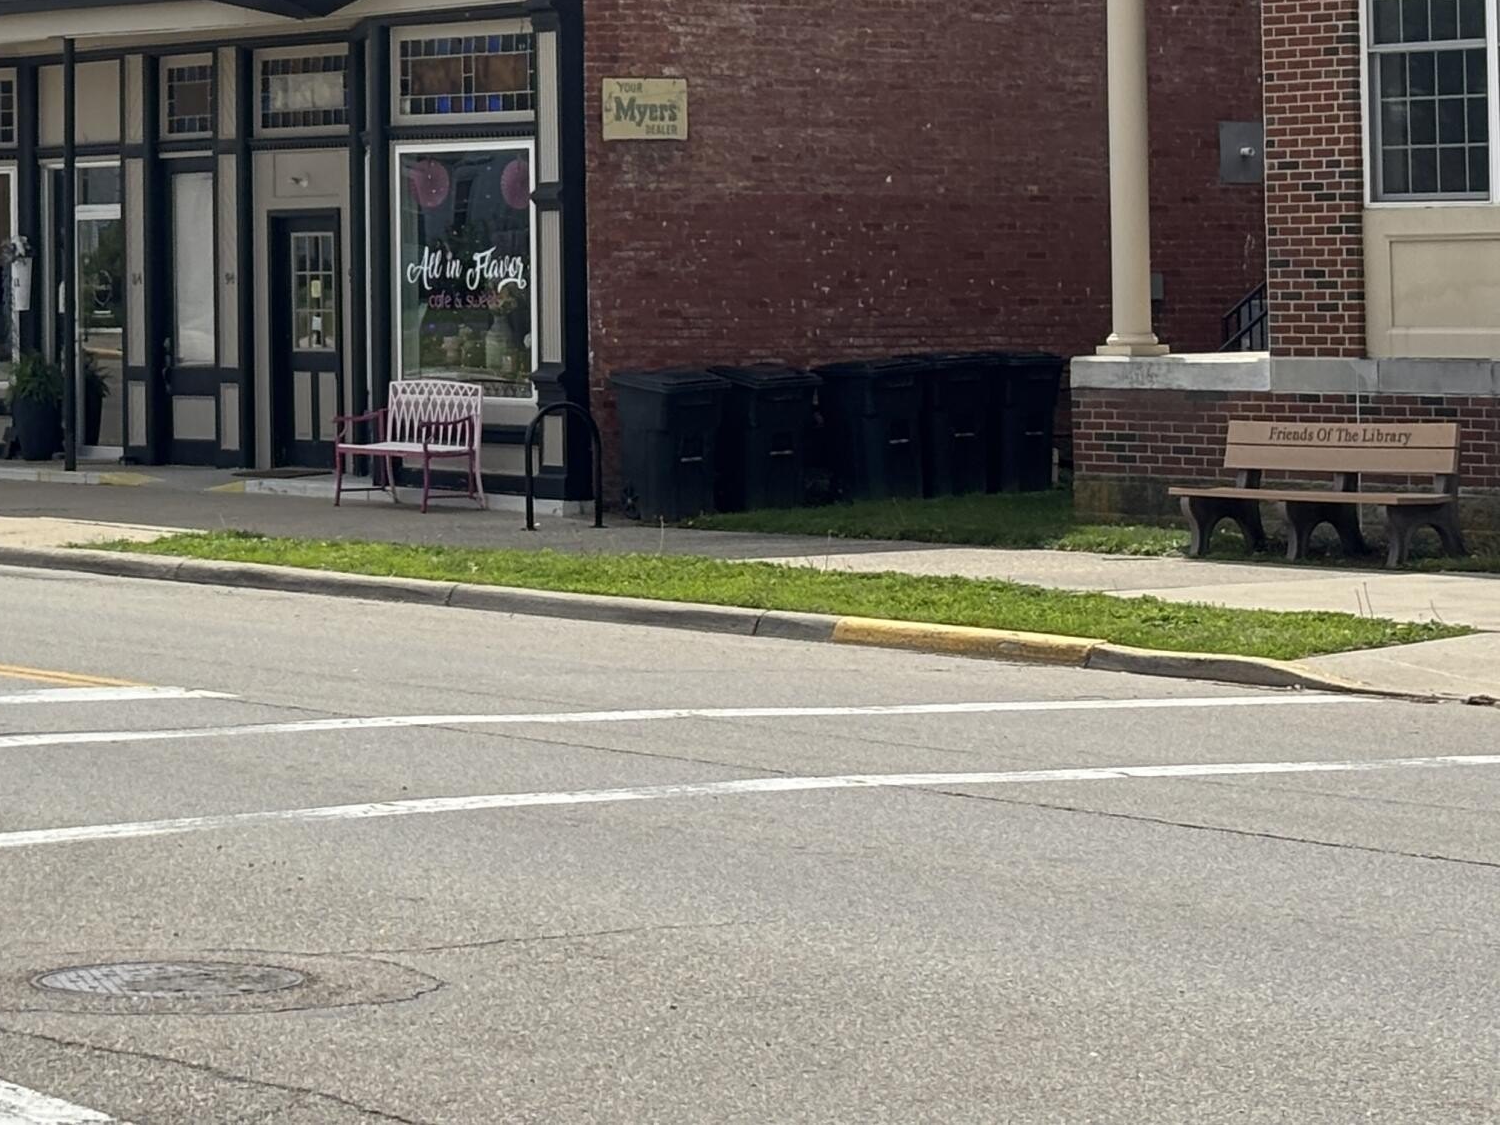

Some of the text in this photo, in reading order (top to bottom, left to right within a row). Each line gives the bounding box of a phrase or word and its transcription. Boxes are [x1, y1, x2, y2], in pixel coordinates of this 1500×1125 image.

[616, 81, 643, 94] YOUR
[614, 95, 678, 127] Myers
[406, 245, 527, 293] All in Flavor
[428, 290, 452, 308] cafe
[1269, 426, 1412, 446] Friends Of The Library
